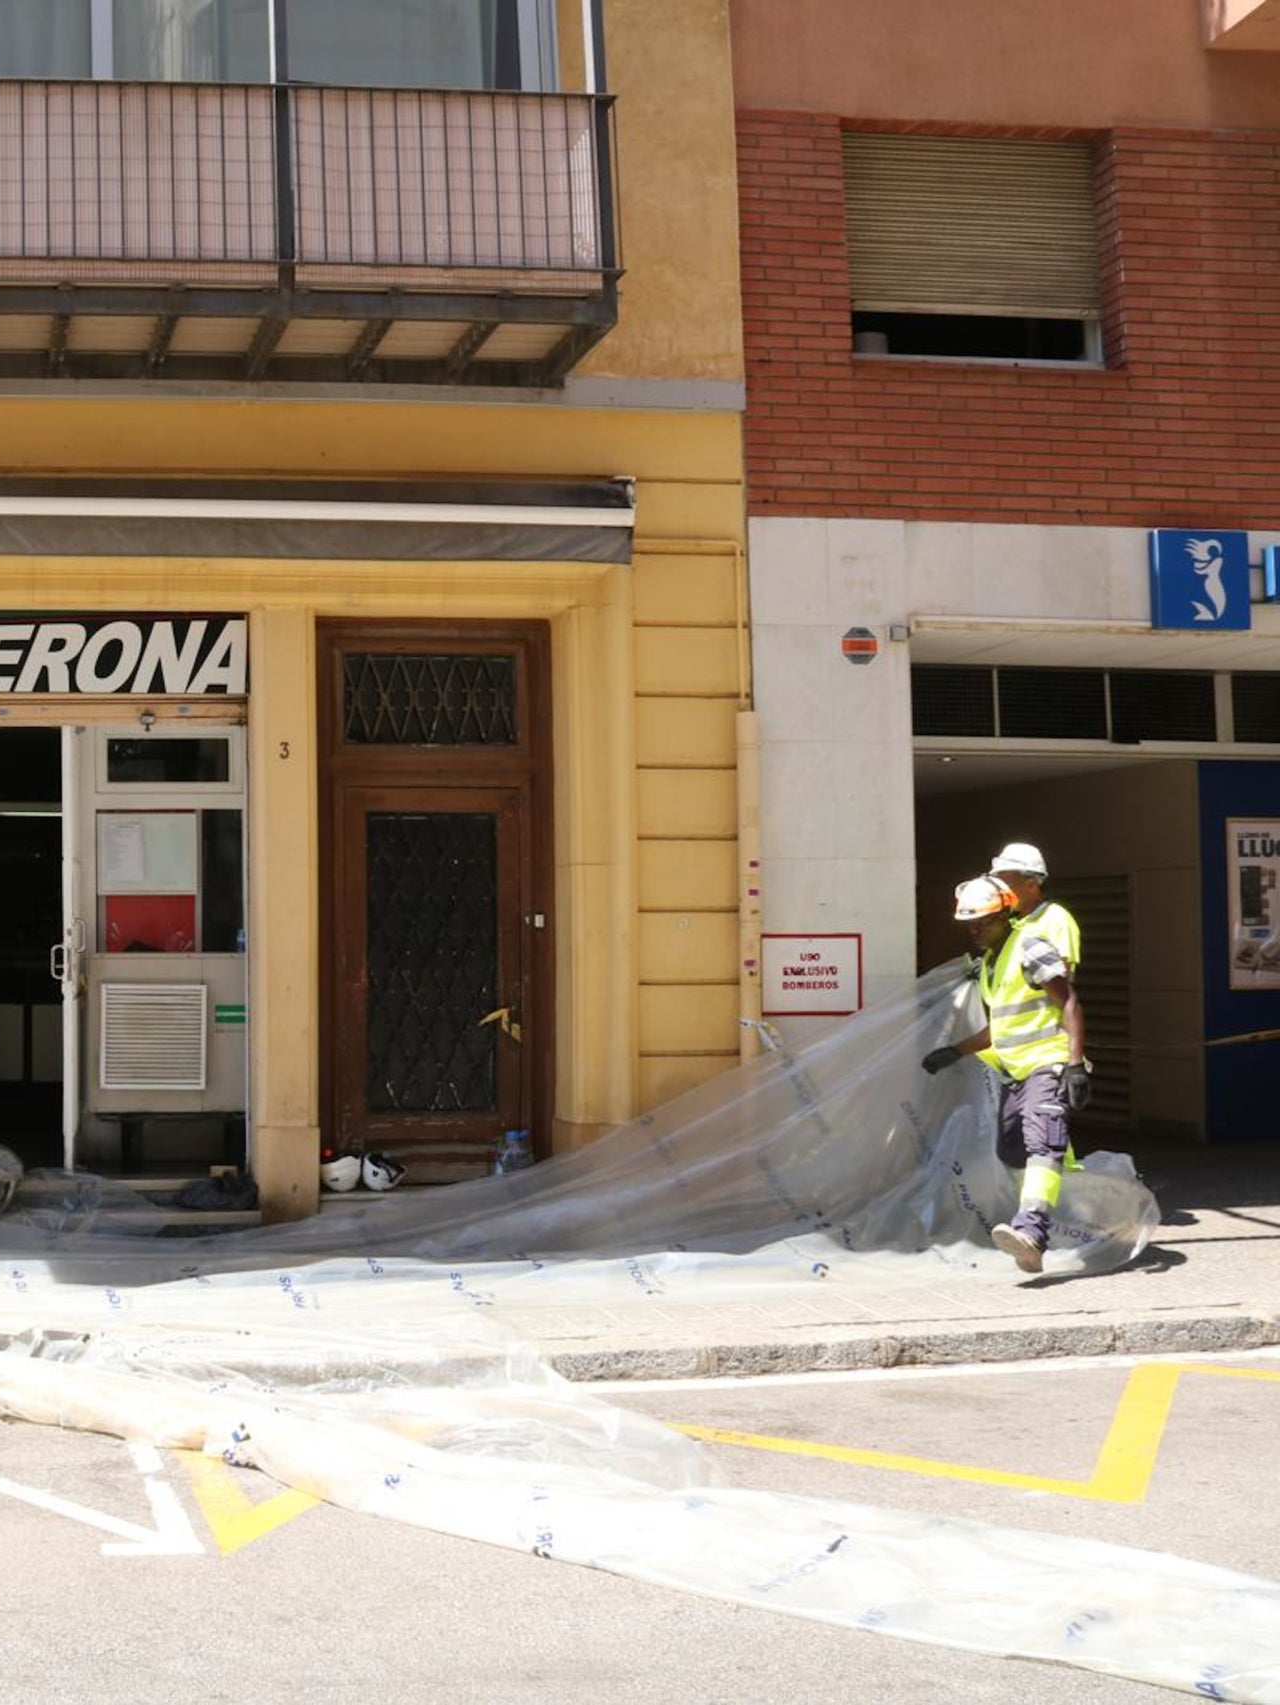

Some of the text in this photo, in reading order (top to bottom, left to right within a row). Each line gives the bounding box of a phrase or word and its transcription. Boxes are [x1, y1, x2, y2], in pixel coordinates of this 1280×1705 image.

[279, 741, 290, 760] 3
[799, 952, 821, 962] USO
[782, 981, 839, 990] BOMBEROS
